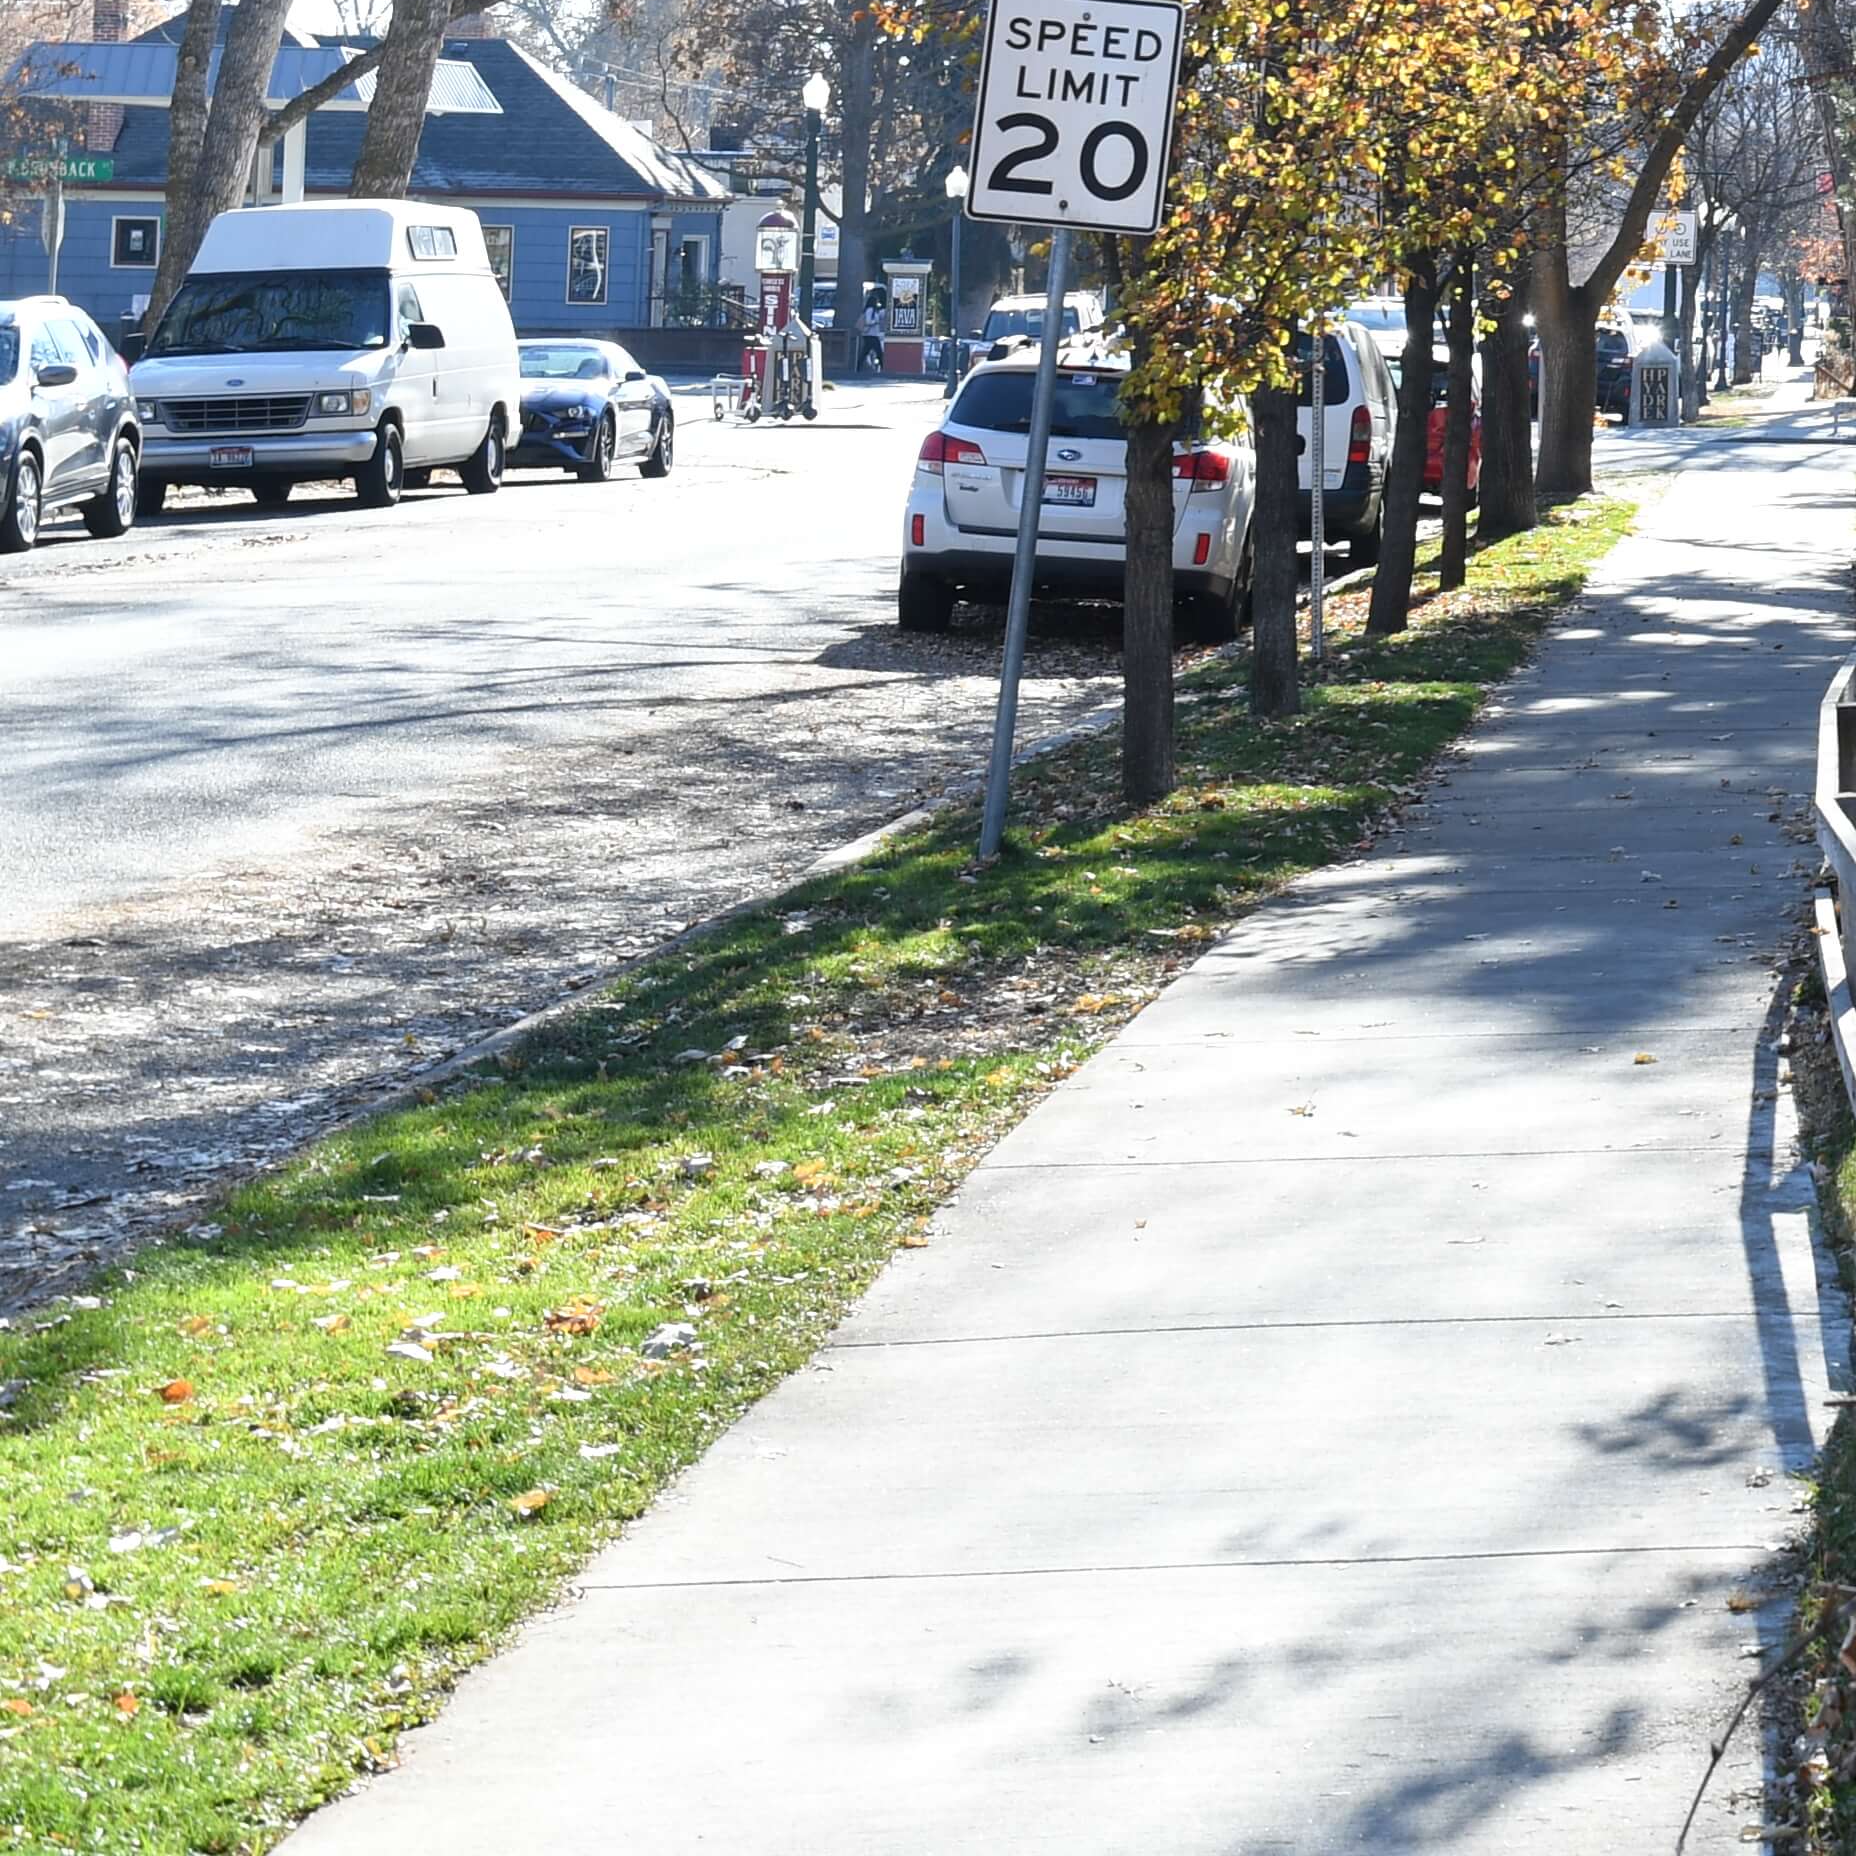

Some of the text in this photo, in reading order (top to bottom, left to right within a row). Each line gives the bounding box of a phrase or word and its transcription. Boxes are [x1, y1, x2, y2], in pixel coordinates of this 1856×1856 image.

[1005, 17, 1162, 62] SPEED
[1016, 66, 1140, 107] LIMIT
[987, 112, 1149, 201] 20
[1671, 250, 1692, 258] LANE
[1673, 239, 1689, 247] USE
[894, 308, 915, 328] JAVA
